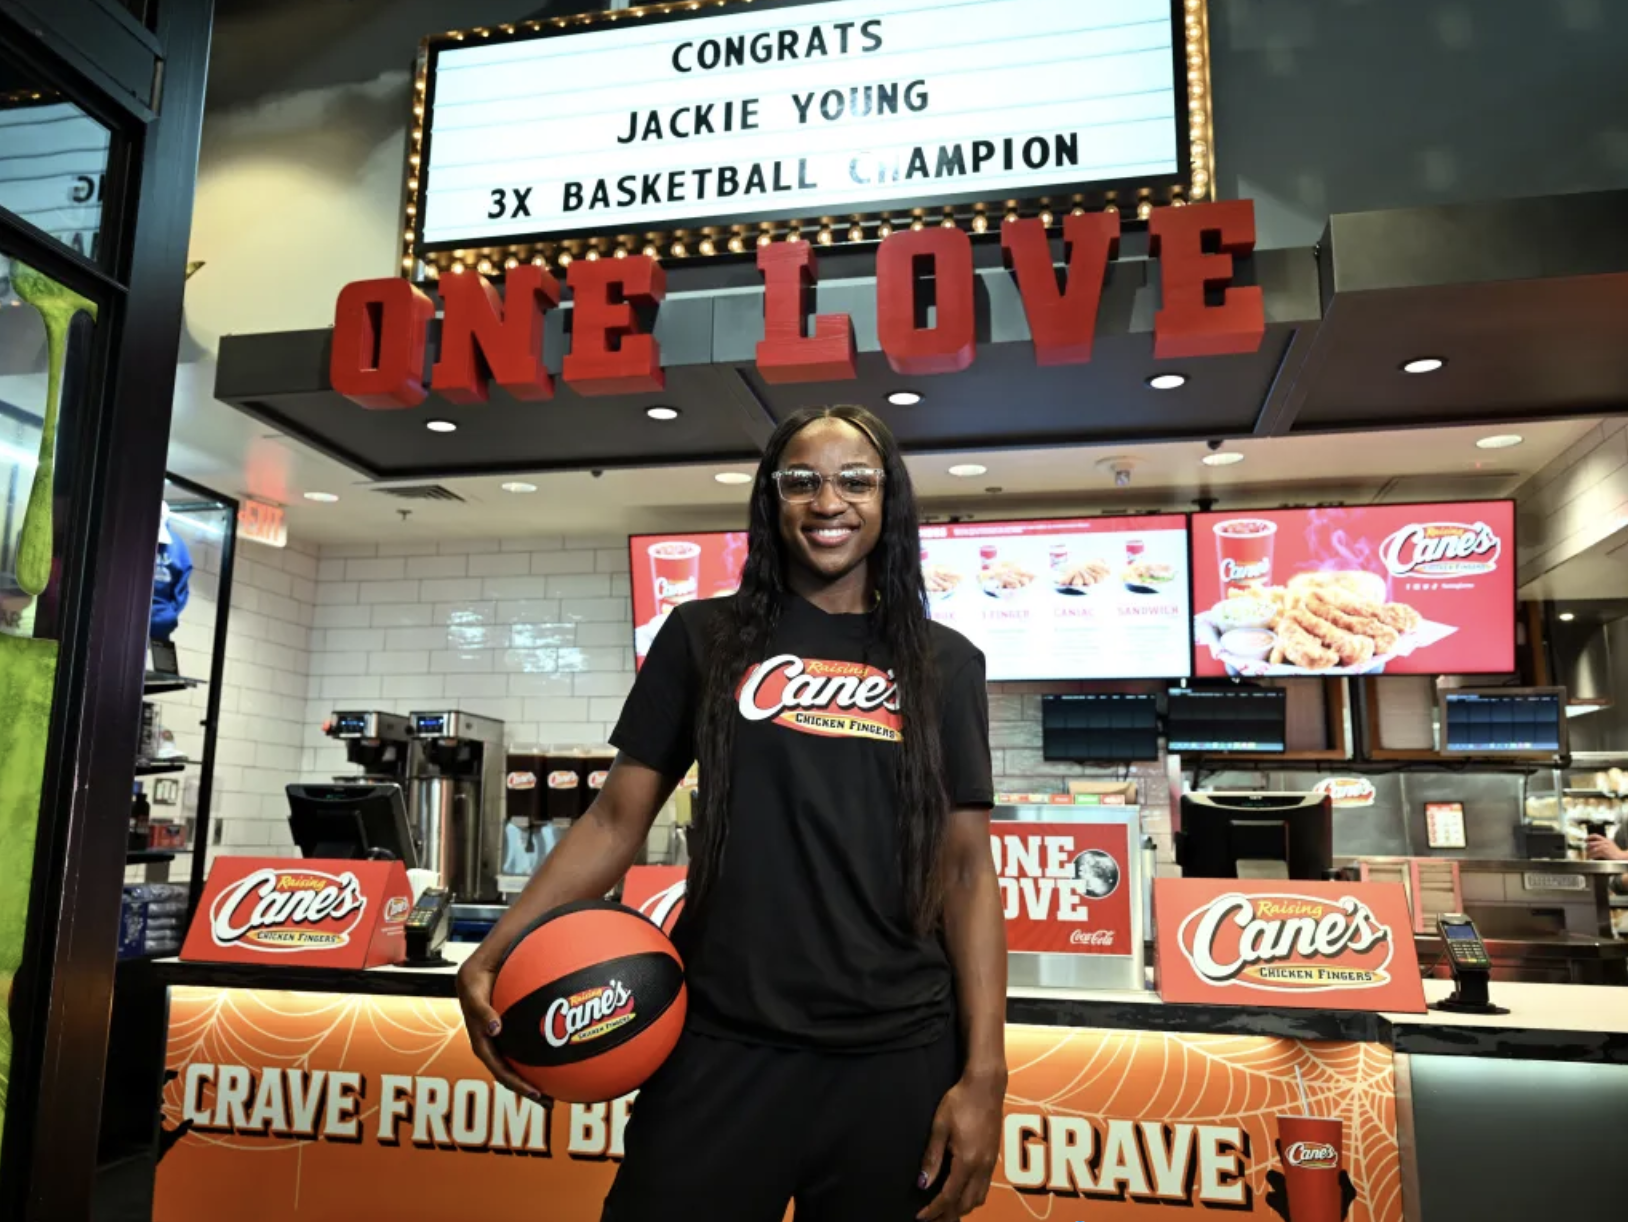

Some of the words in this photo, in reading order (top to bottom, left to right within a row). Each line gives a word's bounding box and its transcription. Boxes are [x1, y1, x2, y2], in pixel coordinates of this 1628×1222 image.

[672, 18, 884, 73] CONGRATS
[617, 98, 760, 144] JACKIE
[791, 79, 930, 126] YOUNG
[487, 187, 533, 220] 3X
[563, 157, 818, 213] BASKETBALL
[330, 253, 667, 411] ONE
[755, 199, 1267, 385] LOVE
[1387, 521, 1499, 575] Cane's
[738, 653, 901, 721] Cane's
[806, 660, 870, 677] Raising
[795, 712, 845, 729] CHICKEN
[849, 720, 897, 739] FINGERS
[214, 868, 364, 943] Cane's
[276, 875, 327, 891] Raising
[998, 877, 1089, 922] OVE
[1256, 899, 1323, 918] Raising
[256, 930, 295, 942] CHICKEN
[298, 932, 337, 944] FINGERS
[1192, 893, 1388, 981] Cane's
[1259, 966, 1314, 979] CHICKEN
[1317, 967, 1374, 981] FINGERS
[545, 978, 632, 1047] Cane's
[182, 1062, 366, 1143] CRAVE
[376, 1073, 553, 1158] FROM
[1003, 1112, 1251, 1210] GRAVE
